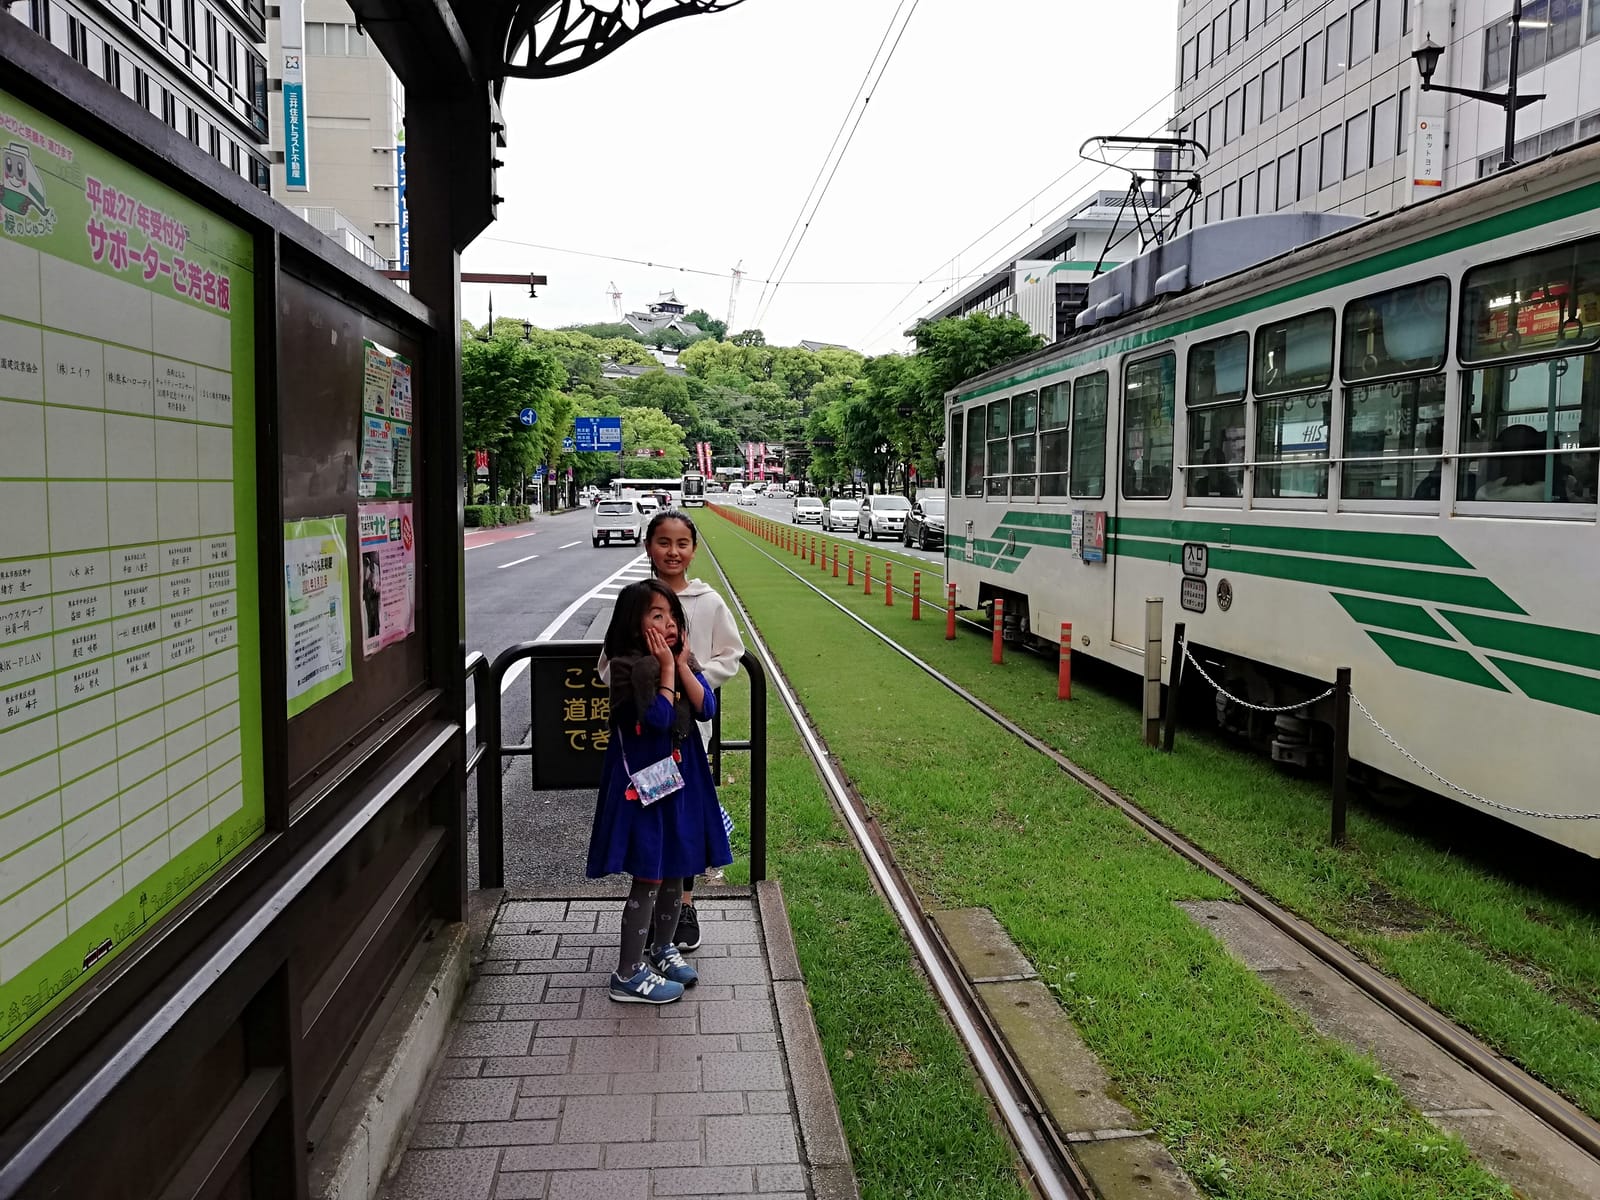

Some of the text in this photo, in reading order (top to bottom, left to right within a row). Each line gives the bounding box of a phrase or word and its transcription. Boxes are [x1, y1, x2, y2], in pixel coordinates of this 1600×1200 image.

[289, 92, 300, 178] 三井住友トラスト不動産
[1425, 133, 1433, 176] ホットヨガ
[86, 177, 187, 252] 平成27年受付分
[87, 219, 231, 311] サポーターご芳名板
[1303, 425, 1322, 442] HIS
[1096, 516, 1104, 541] A
[1188, 546, 1204, 561] 入口
[563, 697, 611, 722] 道路
[565, 729, 610, 750] でき
[658, 958, 671, 973] N
[636, 981, 656, 996] N
